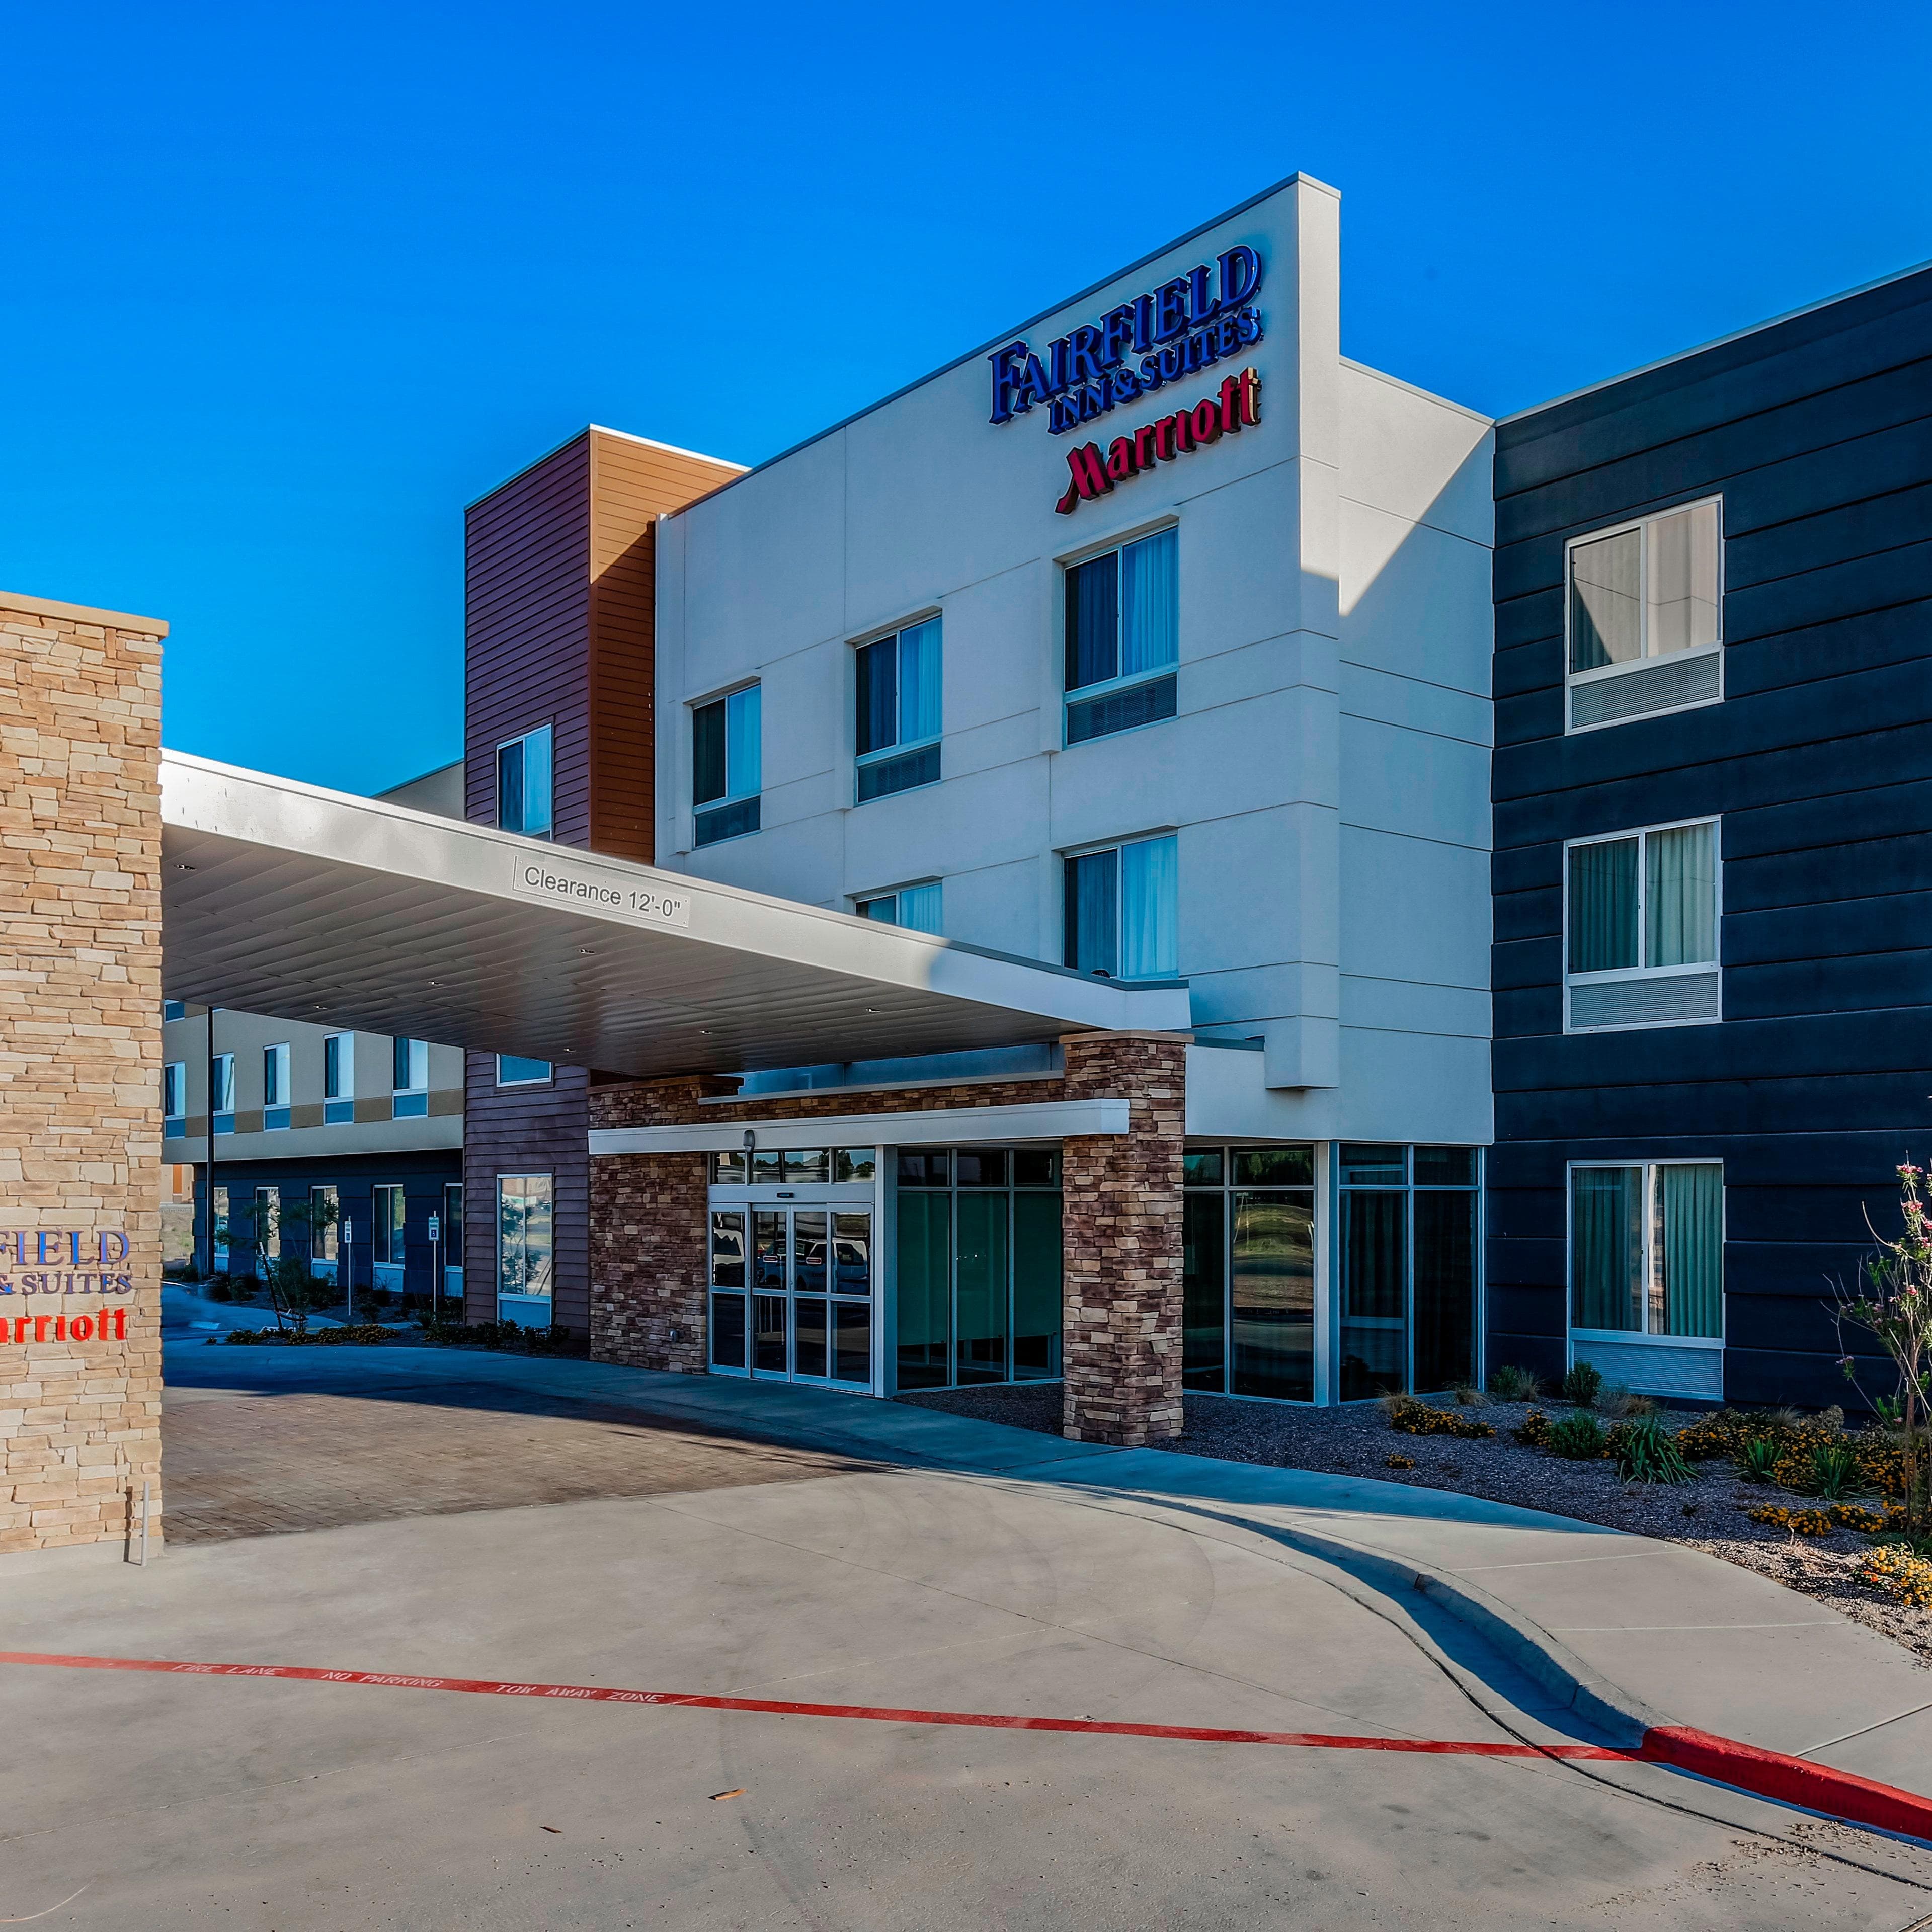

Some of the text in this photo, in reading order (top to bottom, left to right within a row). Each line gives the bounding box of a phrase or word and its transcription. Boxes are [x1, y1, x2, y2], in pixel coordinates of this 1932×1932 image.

[988, 245, 1261, 424] FAIRFIELD
[1047, 378, 1113, 435] INN
[1139, 306, 1263, 391] SUITES
[1055, 367, 1261, 514] Marriott
[524, 866, 681, 917] Clearance 12'-0"
[22, 1273, 132, 1295] SUITES
[172, 1664, 665, 1703] FIRE LANE NO PARKING TOW AWAY ZONE
